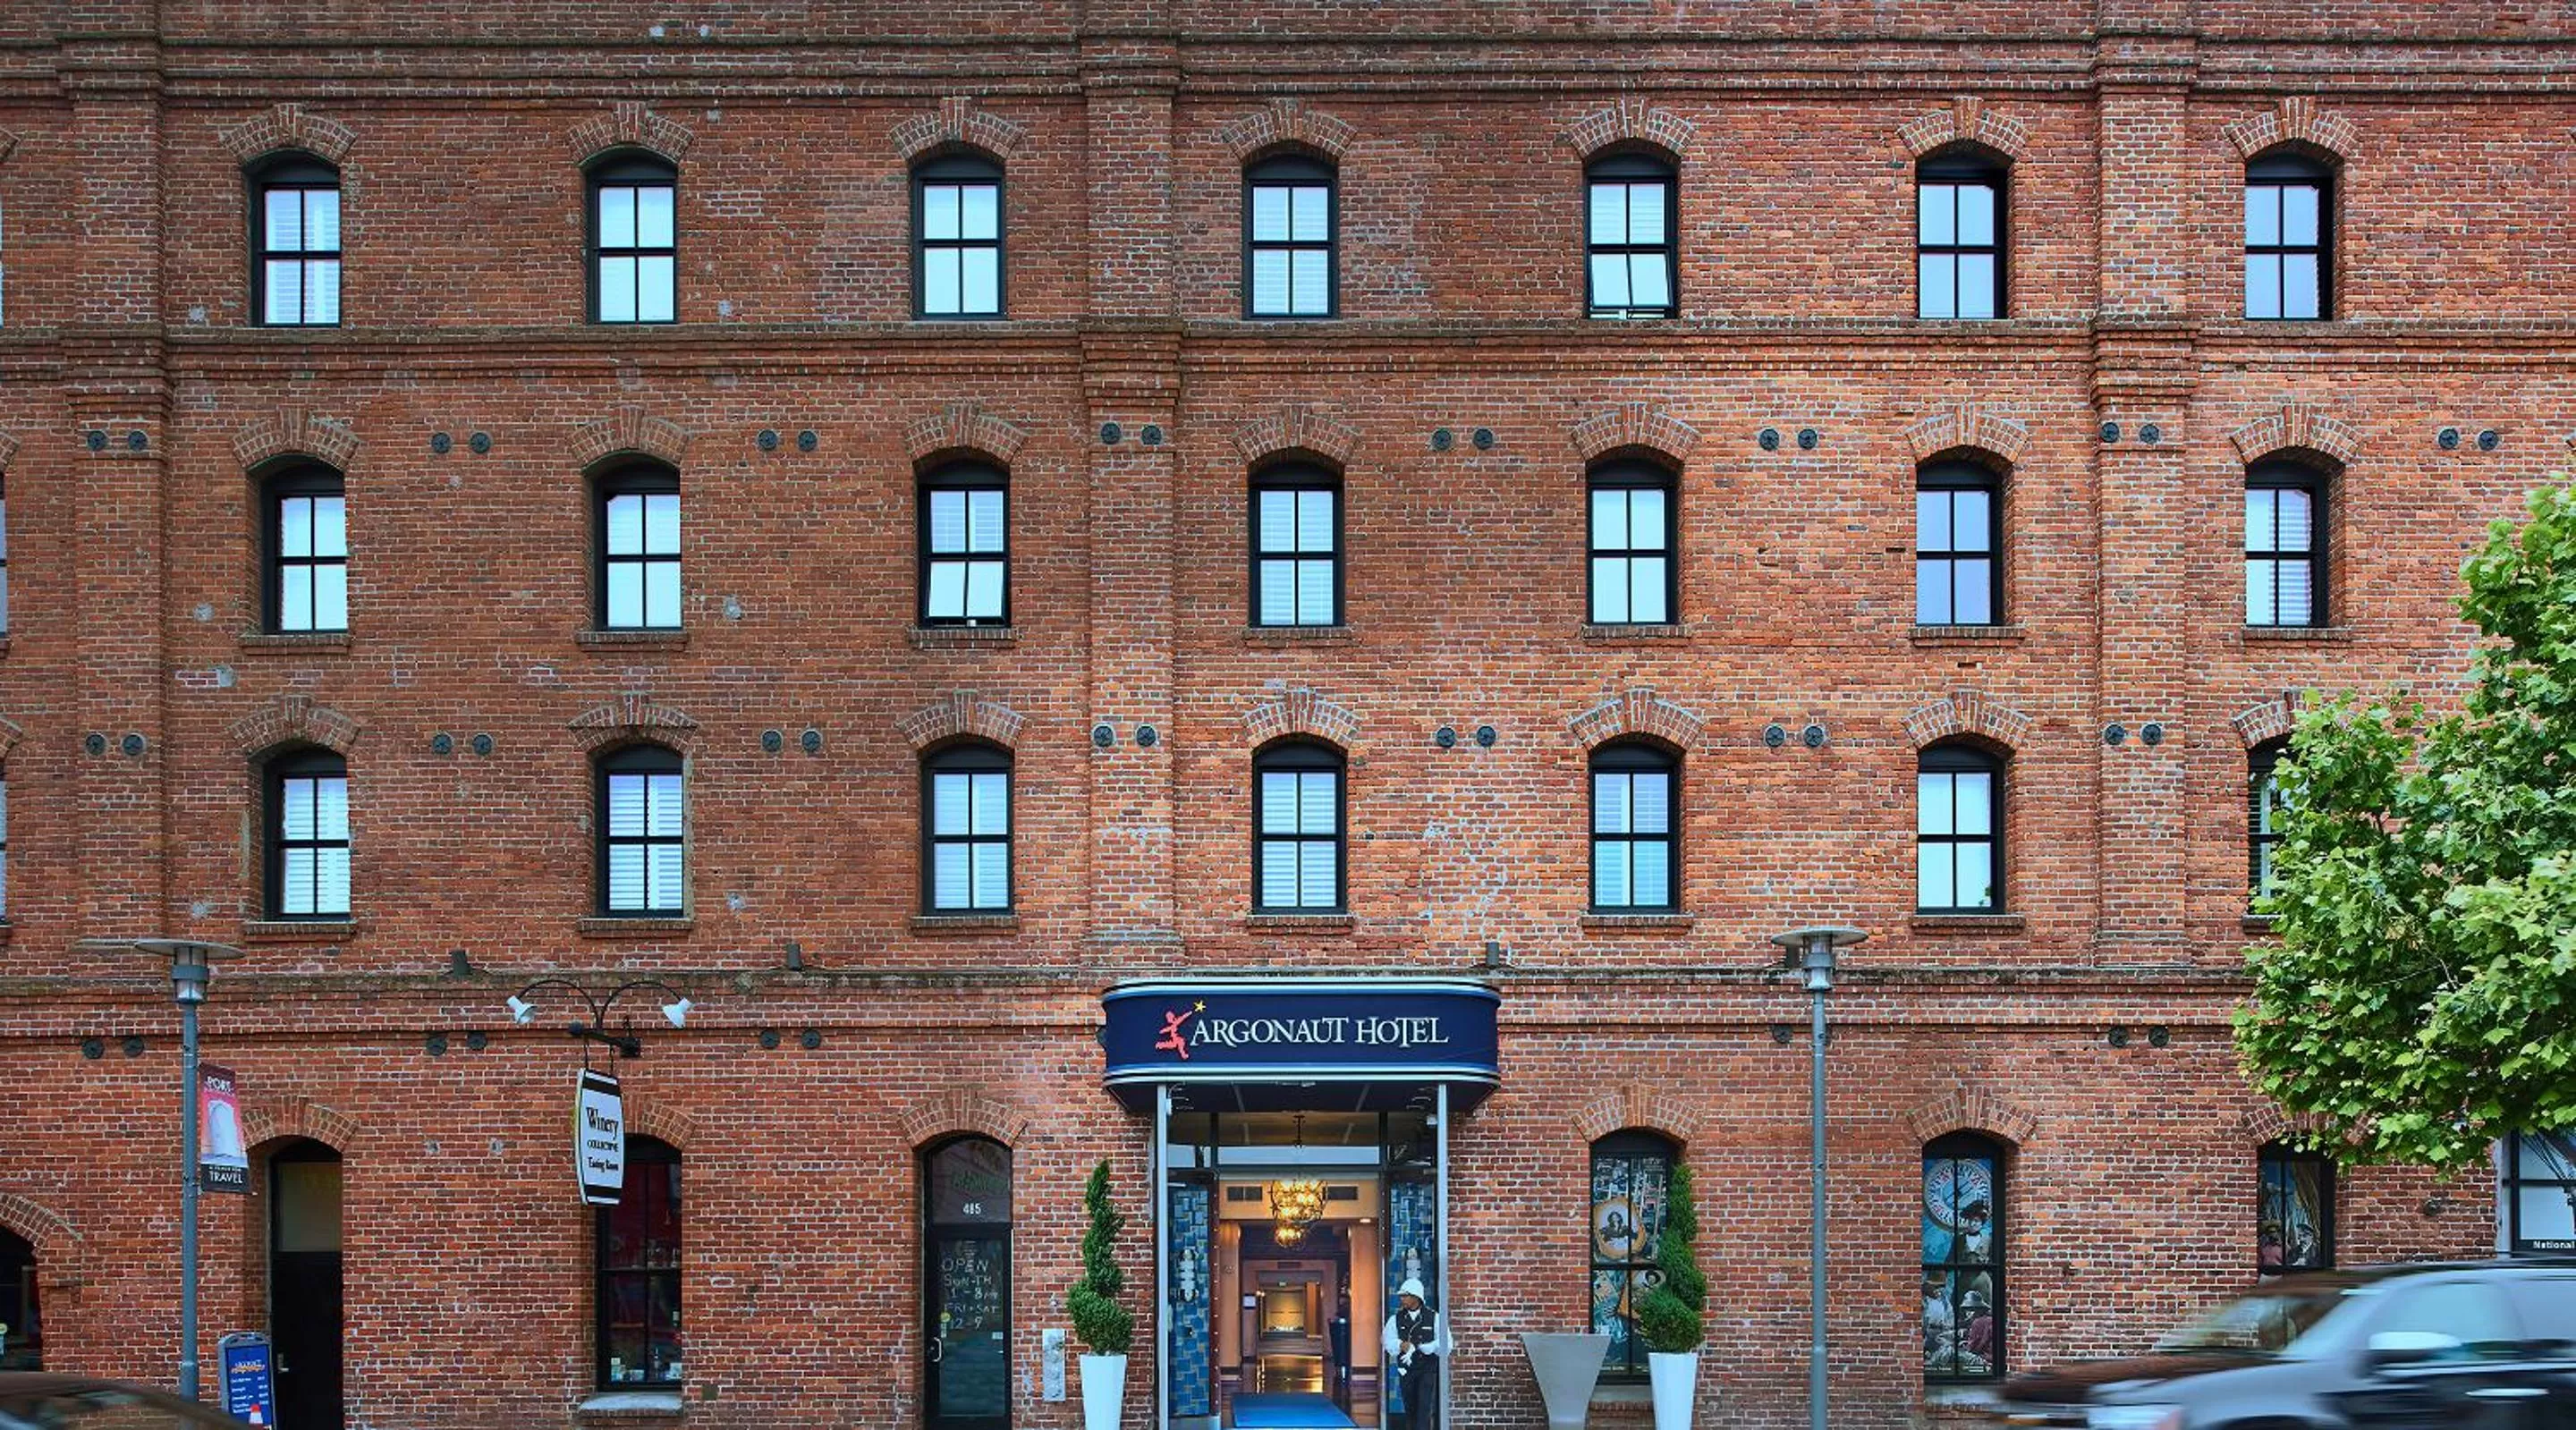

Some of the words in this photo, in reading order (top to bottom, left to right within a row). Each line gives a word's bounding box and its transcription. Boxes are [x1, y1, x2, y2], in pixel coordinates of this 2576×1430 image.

[1191, 1017, 1348, 1047] ARGONAUT
[1354, 1016, 1449, 1048] HOTEL
[208, 1171, 243, 1183] TRAVEL
[2532, 1240, 2575, 1249] National
[942, 1257, 988, 1273] OPEN
